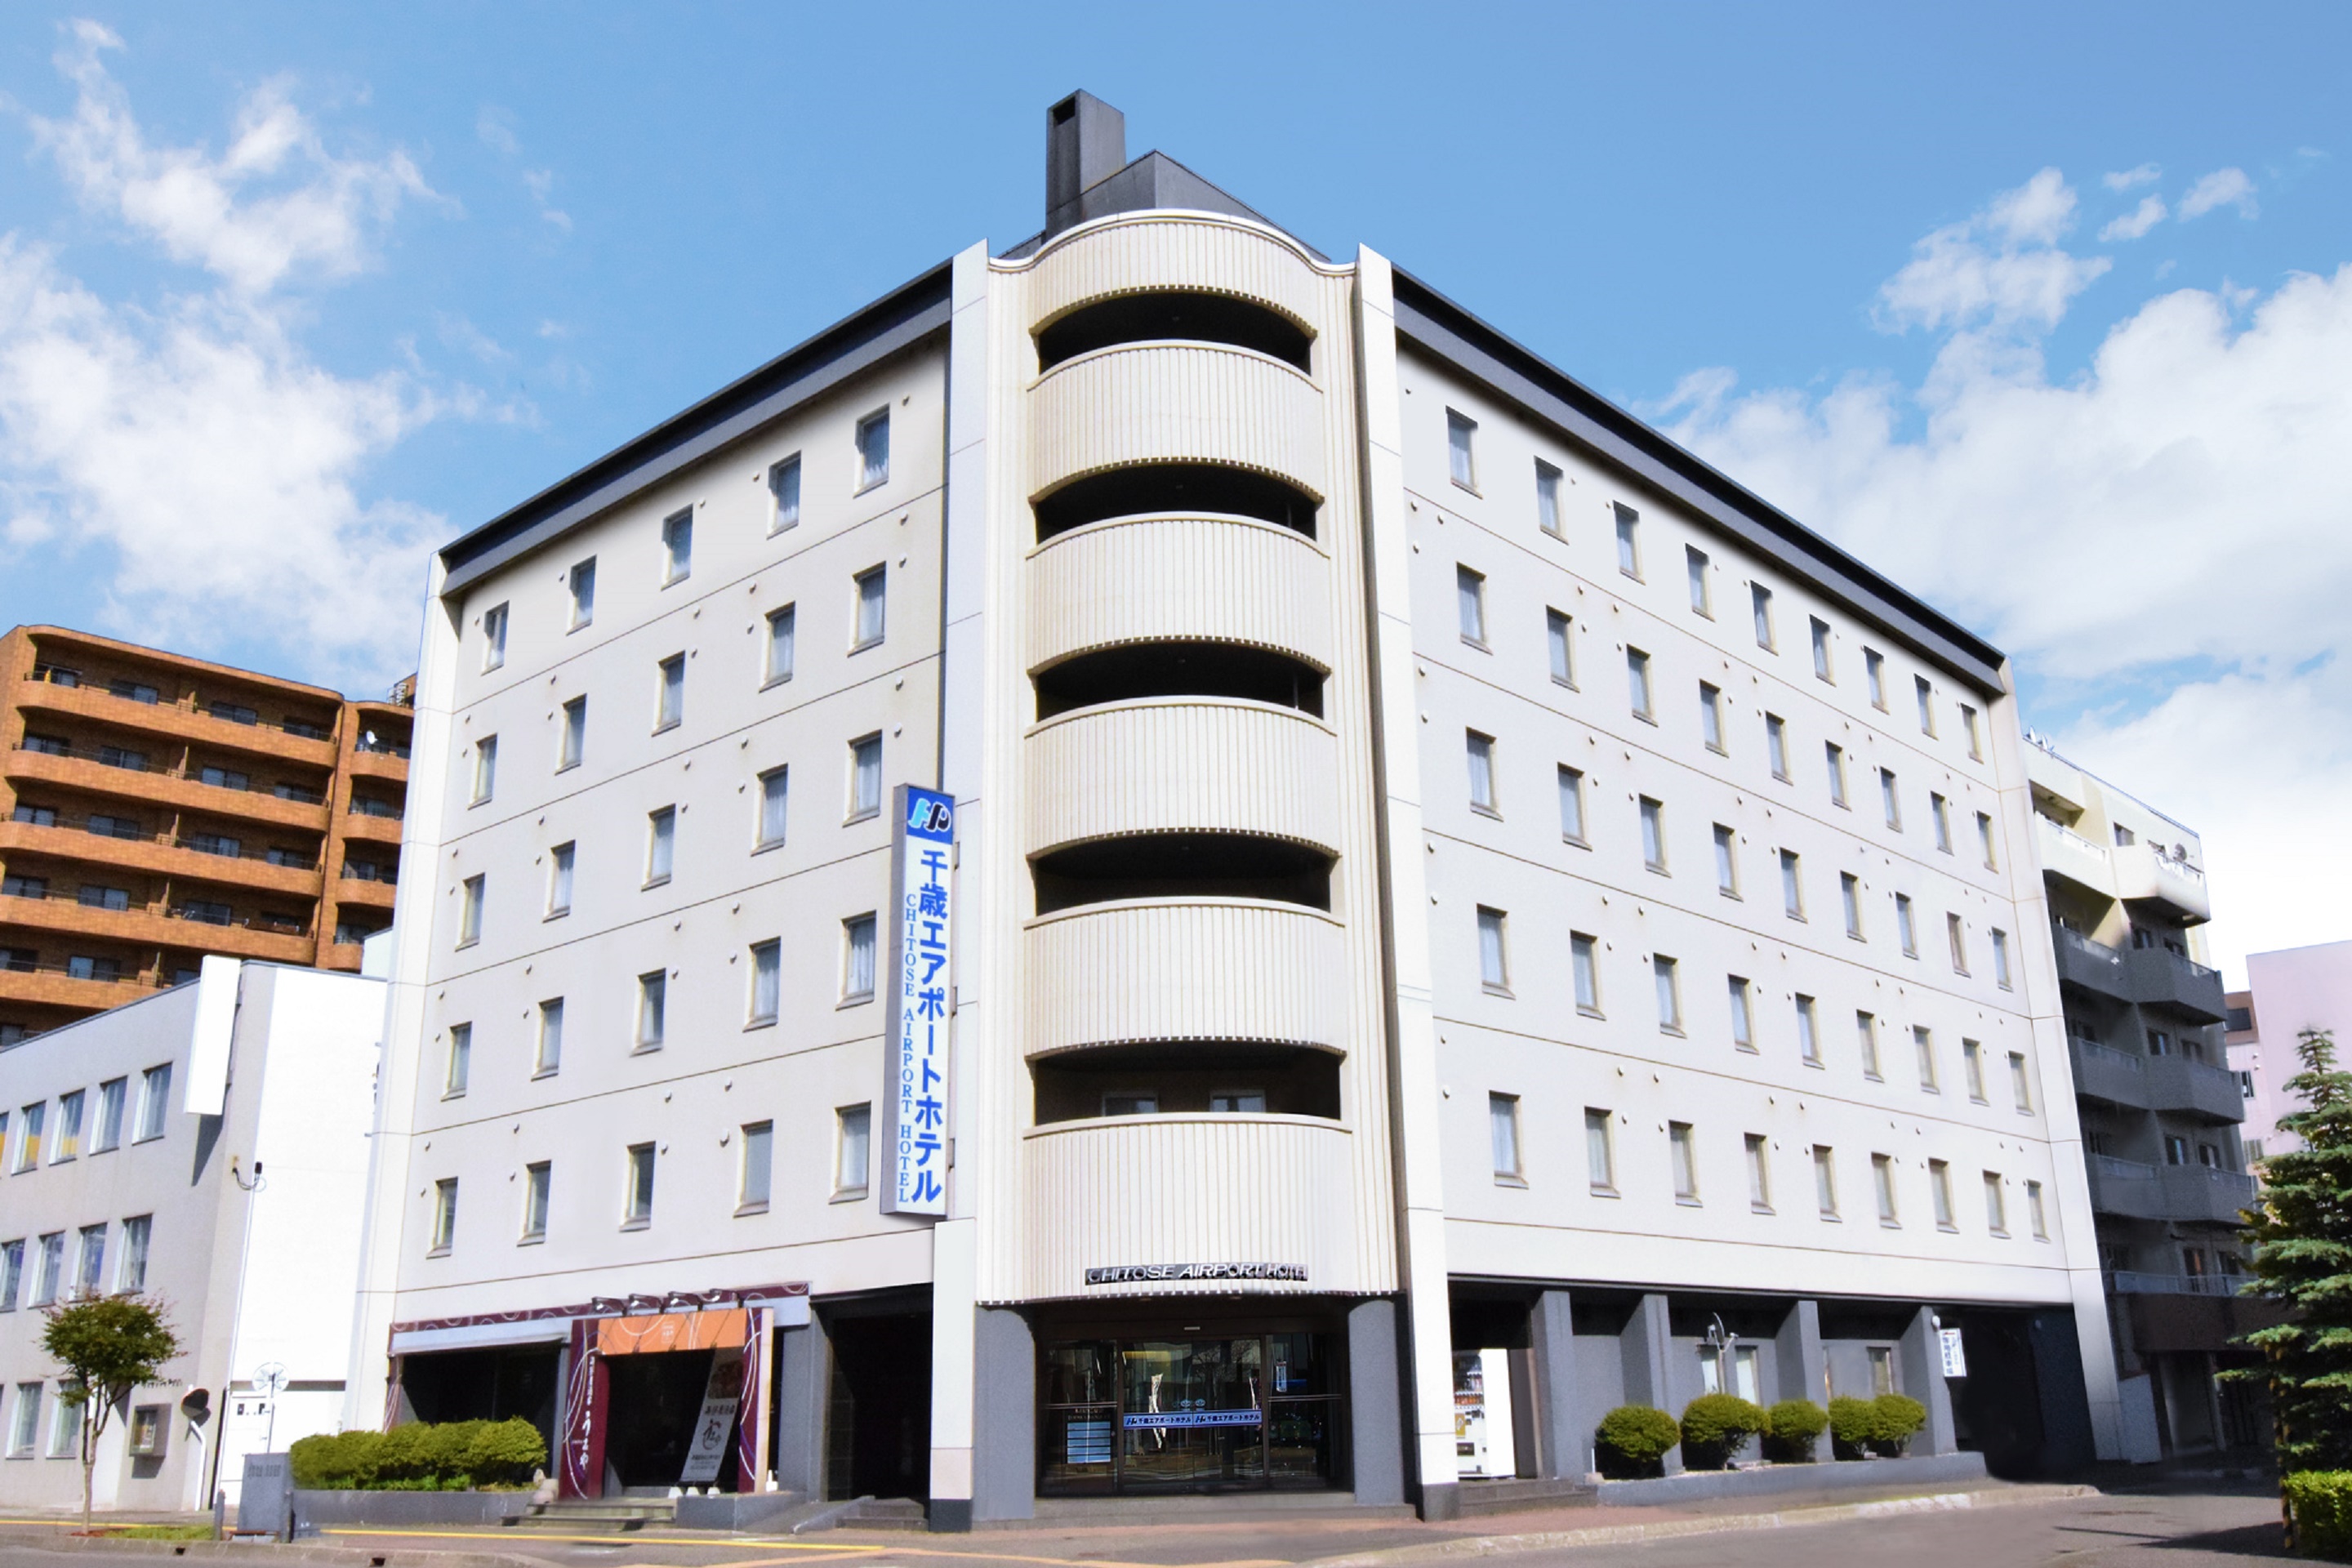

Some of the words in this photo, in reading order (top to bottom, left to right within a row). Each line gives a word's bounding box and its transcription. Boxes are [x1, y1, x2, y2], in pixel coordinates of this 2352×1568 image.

[904, 893, 916, 997] CHITOSE
[902, 1009, 915, 1114] AIRPORT
[911, 849, 948, 1205] 千歳エアポートホテル
[898, 1125, 910, 1203] HOTEL
[1087, 1265, 1175, 1284] CHITOSE
[1178, 1264, 1263, 1278] AIRPORT
